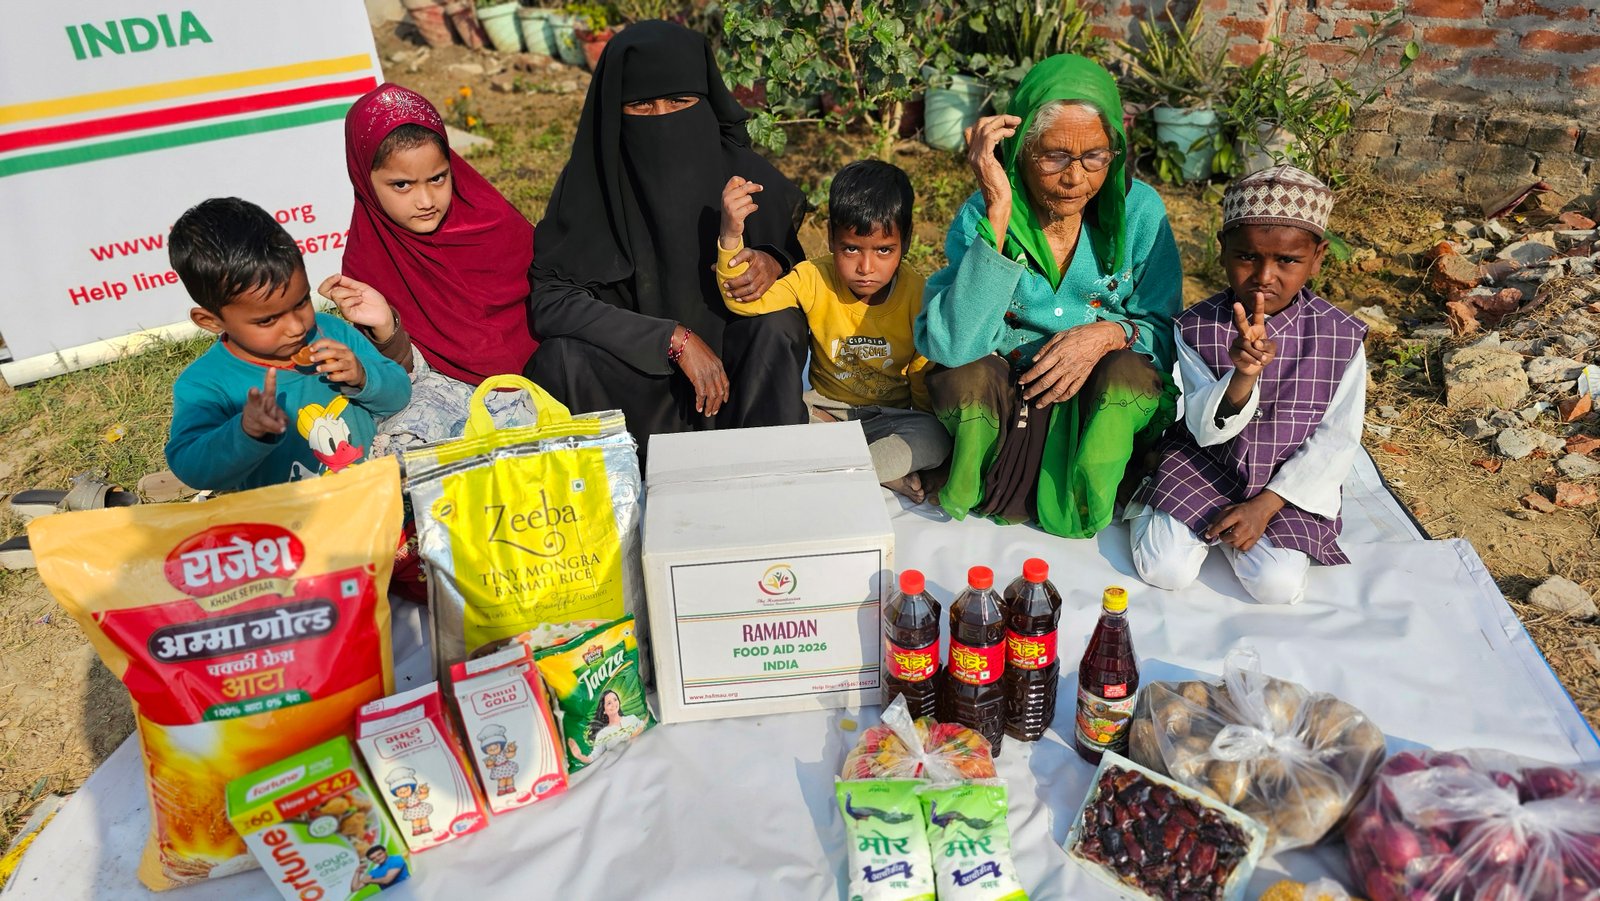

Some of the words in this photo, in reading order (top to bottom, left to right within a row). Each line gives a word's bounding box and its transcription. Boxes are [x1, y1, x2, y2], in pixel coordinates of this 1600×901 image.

[65, 10, 213, 61] INDIA
[68, 281, 128, 306] Help
[132, 270, 179, 292] line
[484, 489, 578, 557] Zeeba
[180, 535, 297, 588] राजेश
[479, 567, 525, 586] TINY
[525, 553, 601, 579] MONGRA
[210, 592, 238, 608] KHANE
[239, 588, 248, 598] SE
[249, 580, 275, 594] PYAAR
[495, 575, 555, 597] BASMATI
[560, 567, 593, 584] RICE
[157, 622, 247, 658] अम्मा
[249, 606, 332, 640] गोल्ड
[742, 619, 818, 642] RAMADAN
[207, 652, 257, 677] चक्की
[262, 648, 295, 668] फ्रेश
[733, 646, 769, 658] FOOD
[773, 644, 795, 655] AID
[798, 642, 828, 653] 2026
[577, 649, 625, 701] Taaza
[763, 660, 799, 671] INDIA
[221, 667, 286, 698] आटा
[481, 684, 517, 701] Amul
[213, 705, 241, 718] 100%
[485, 693, 517, 708] GOLD
[253, 773, 299, 797] fortune
[857, 829, 911, 856] मोर
[943, 830, 996, 858] मोर
[314, 850, 349, 871] soya
